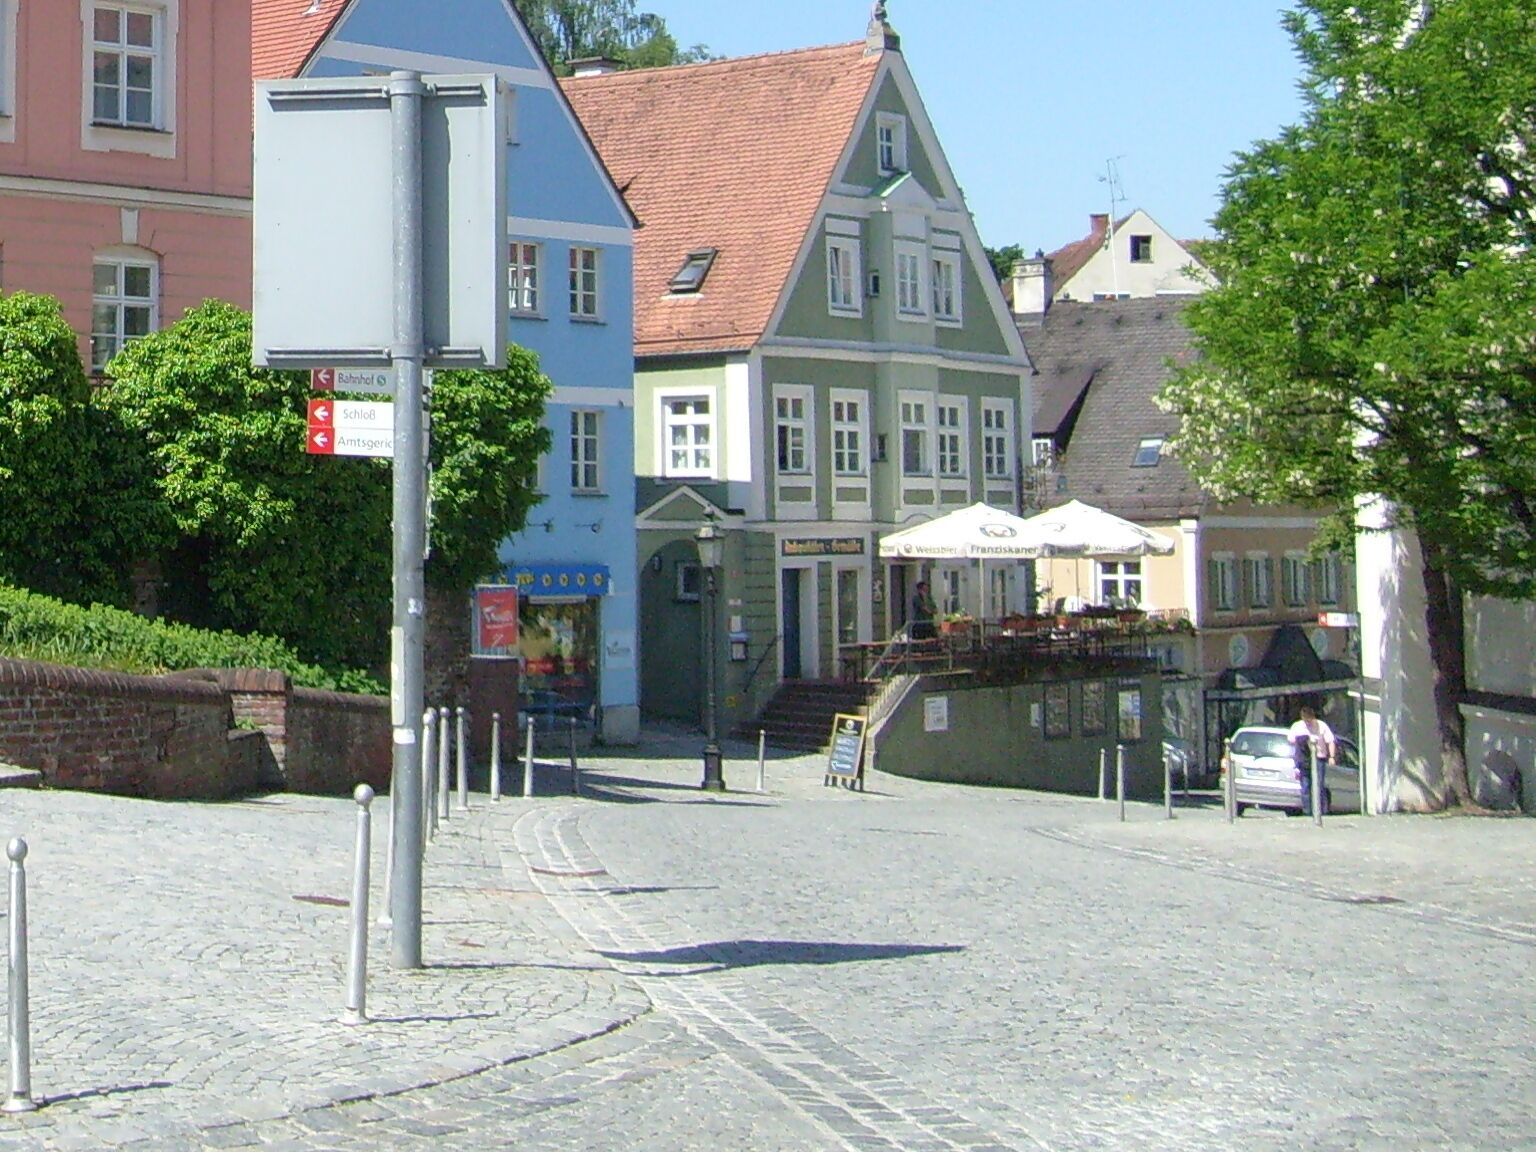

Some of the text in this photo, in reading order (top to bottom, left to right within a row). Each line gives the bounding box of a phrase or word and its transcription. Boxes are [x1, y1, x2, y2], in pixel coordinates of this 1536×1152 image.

[338, 372, 374, 385] Bahnhof
[343, 408, 376, 420] Schloß
[338, 436, 392, 450] Amtsgeric
[970, 544, 1038, 555] Franziskaner
